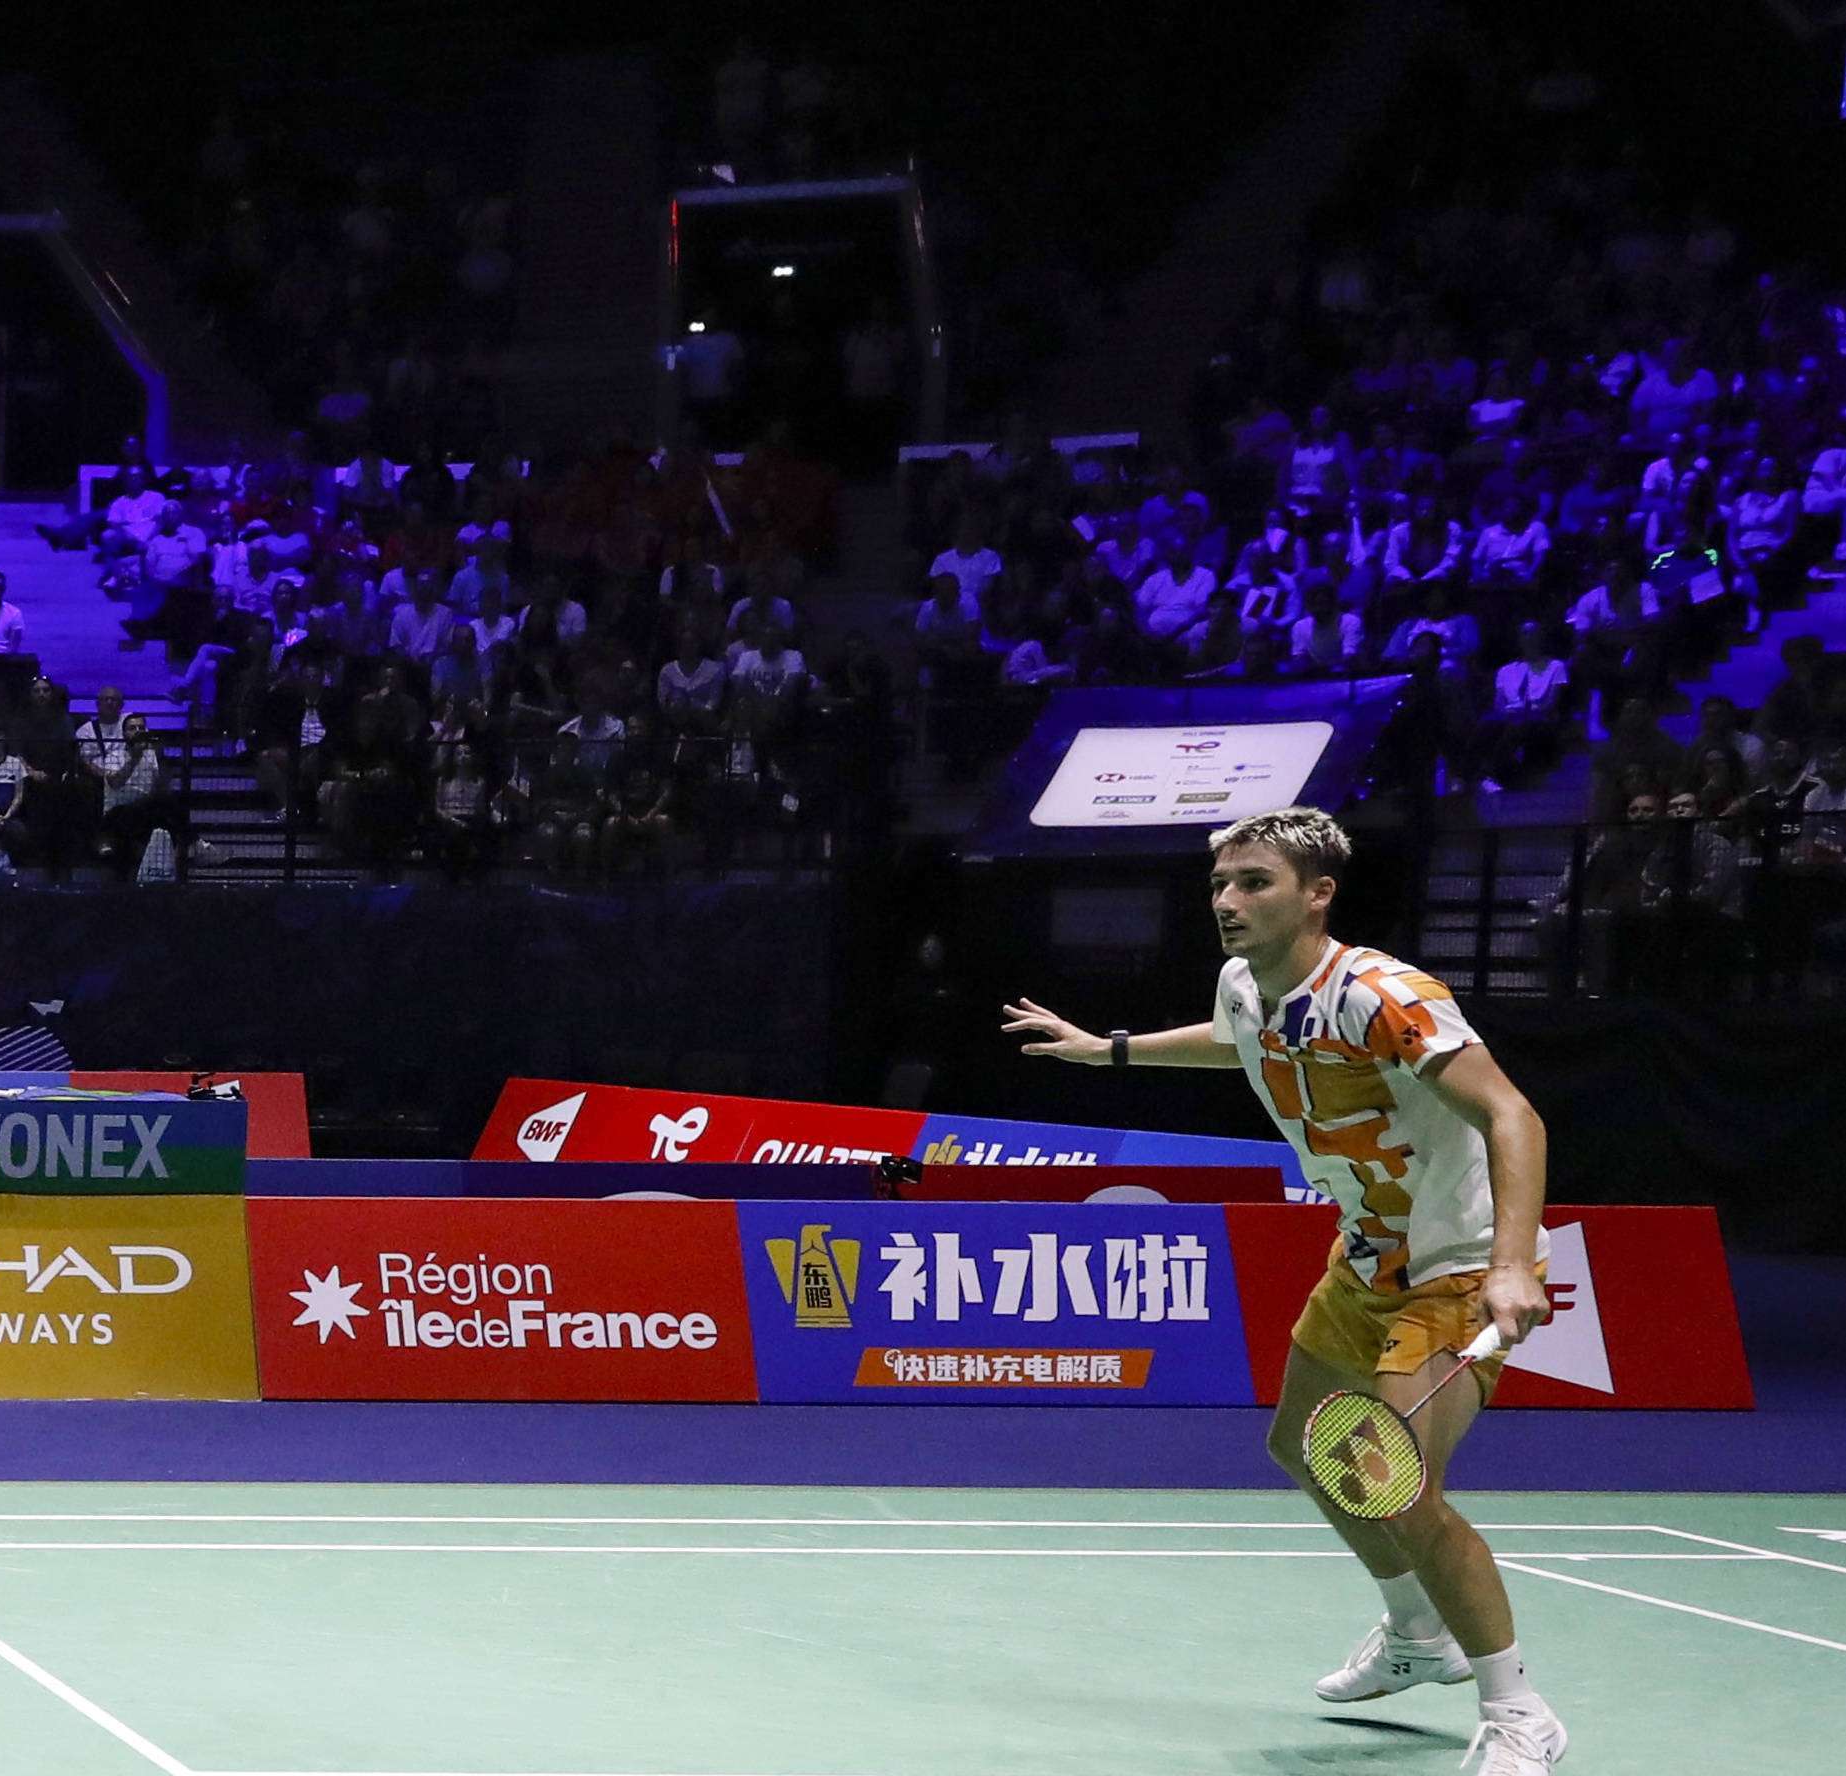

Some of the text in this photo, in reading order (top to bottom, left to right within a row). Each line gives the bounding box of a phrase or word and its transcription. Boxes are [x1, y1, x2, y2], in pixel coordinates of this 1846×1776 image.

[523, 1119, 567, 1143] BWF
[379, 1253, 552, 1302] Région
[878, 1233, 1209, 1321] 补水啦
[892, 1353, 1122, 1384] 快速补充电解质
